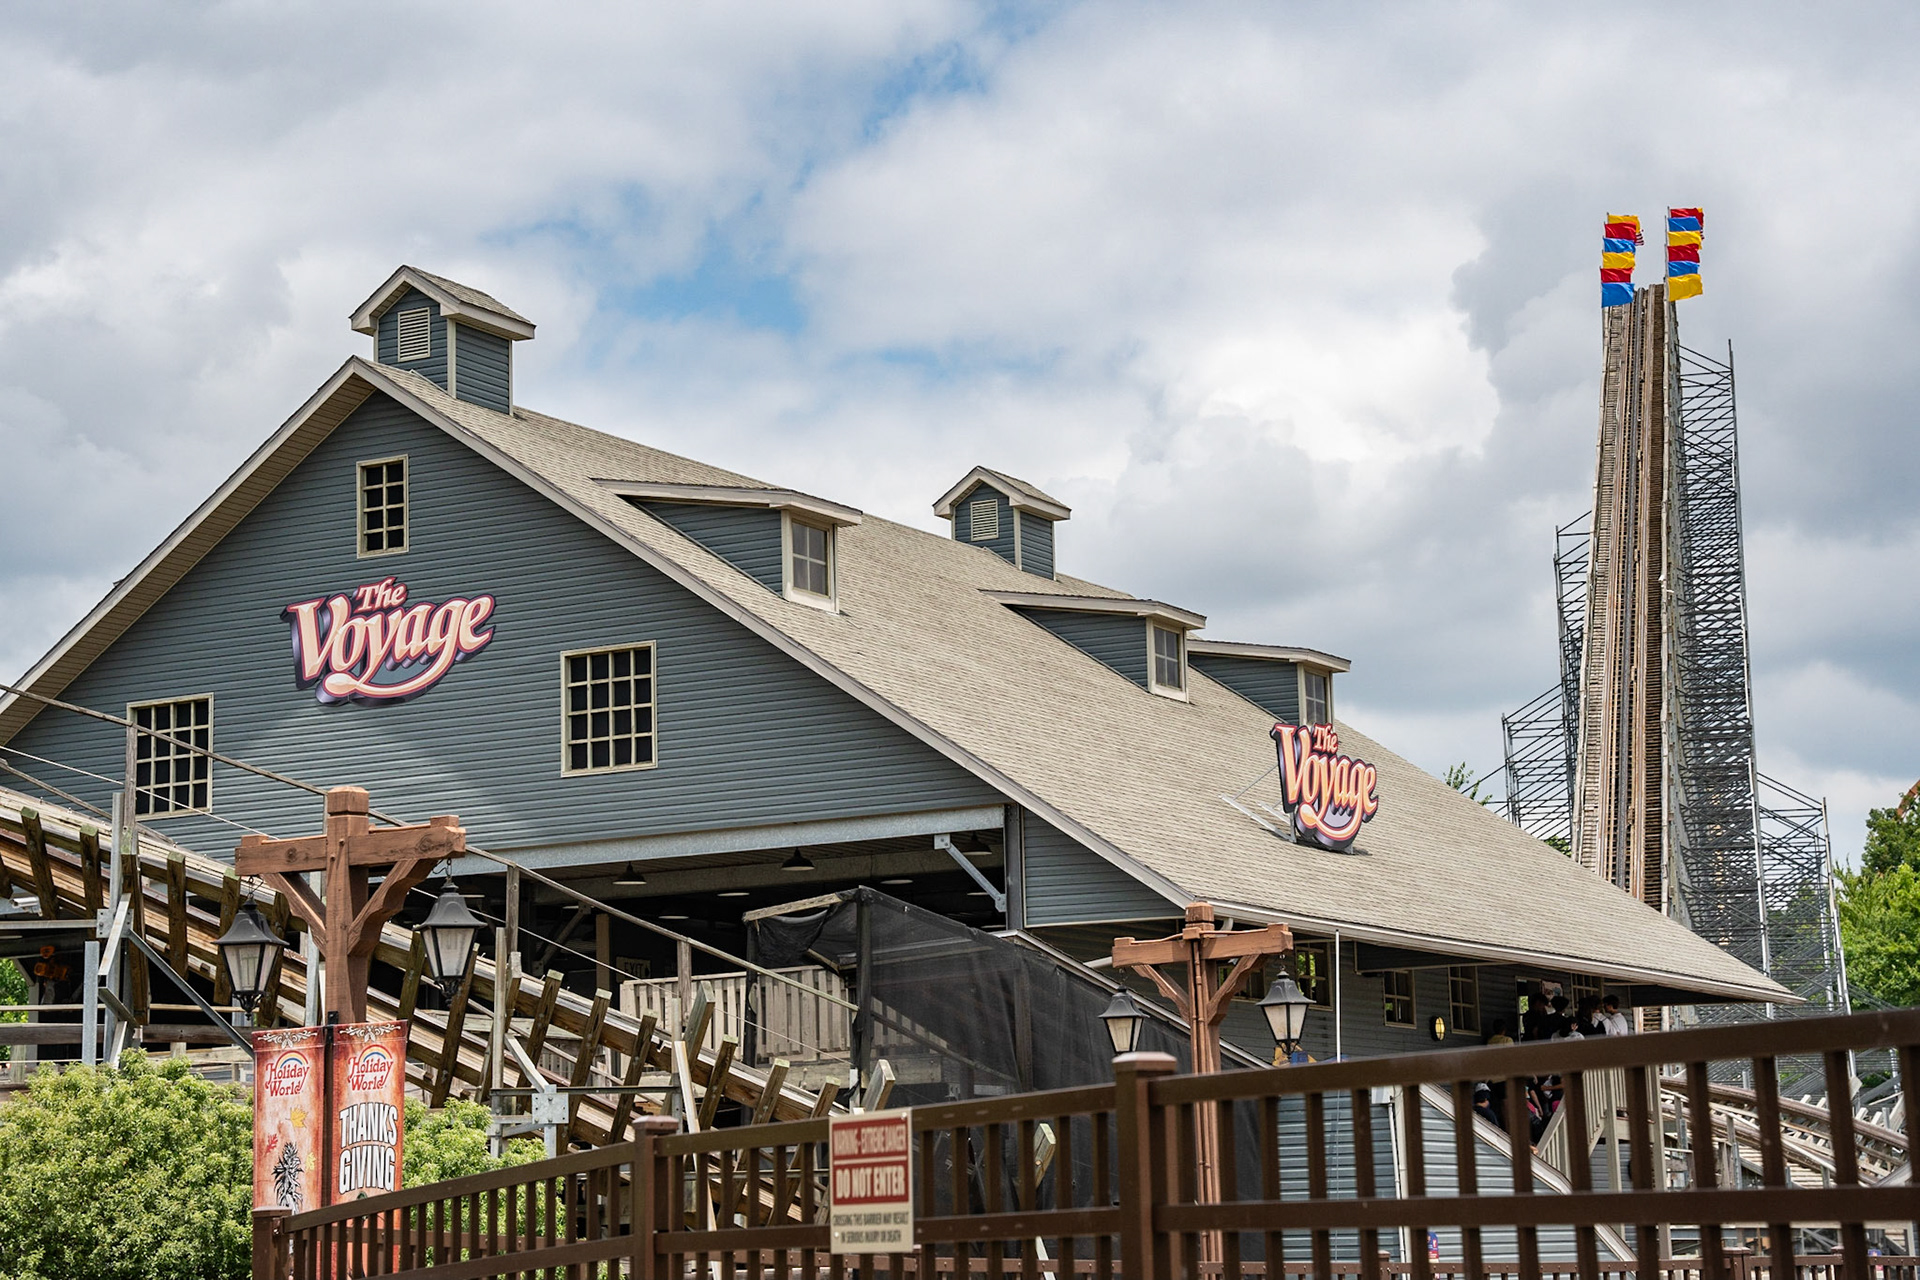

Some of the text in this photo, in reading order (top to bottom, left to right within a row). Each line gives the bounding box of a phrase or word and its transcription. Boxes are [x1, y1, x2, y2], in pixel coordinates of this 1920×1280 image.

[354, 576, 408, 613] The
[286, 593, 495, 699] Voyage
[1312, 723, 1339, 753] The
[1273, 723, 1379, 841] Voyage
[624, 961, 643, 977] EXIT
[265, 1061, 310, 1085] Holiday
[347, 1056, 394, 1082] Holiday
[347, 1073, 387, 1091] World
[264, 1078, 304, 1097] World
[339, 1102, 398, 1149] THANKS
[339, 1145, 396, 1195] GIVING
[836, 1166, 905, 1199] DO NOT ENTER
